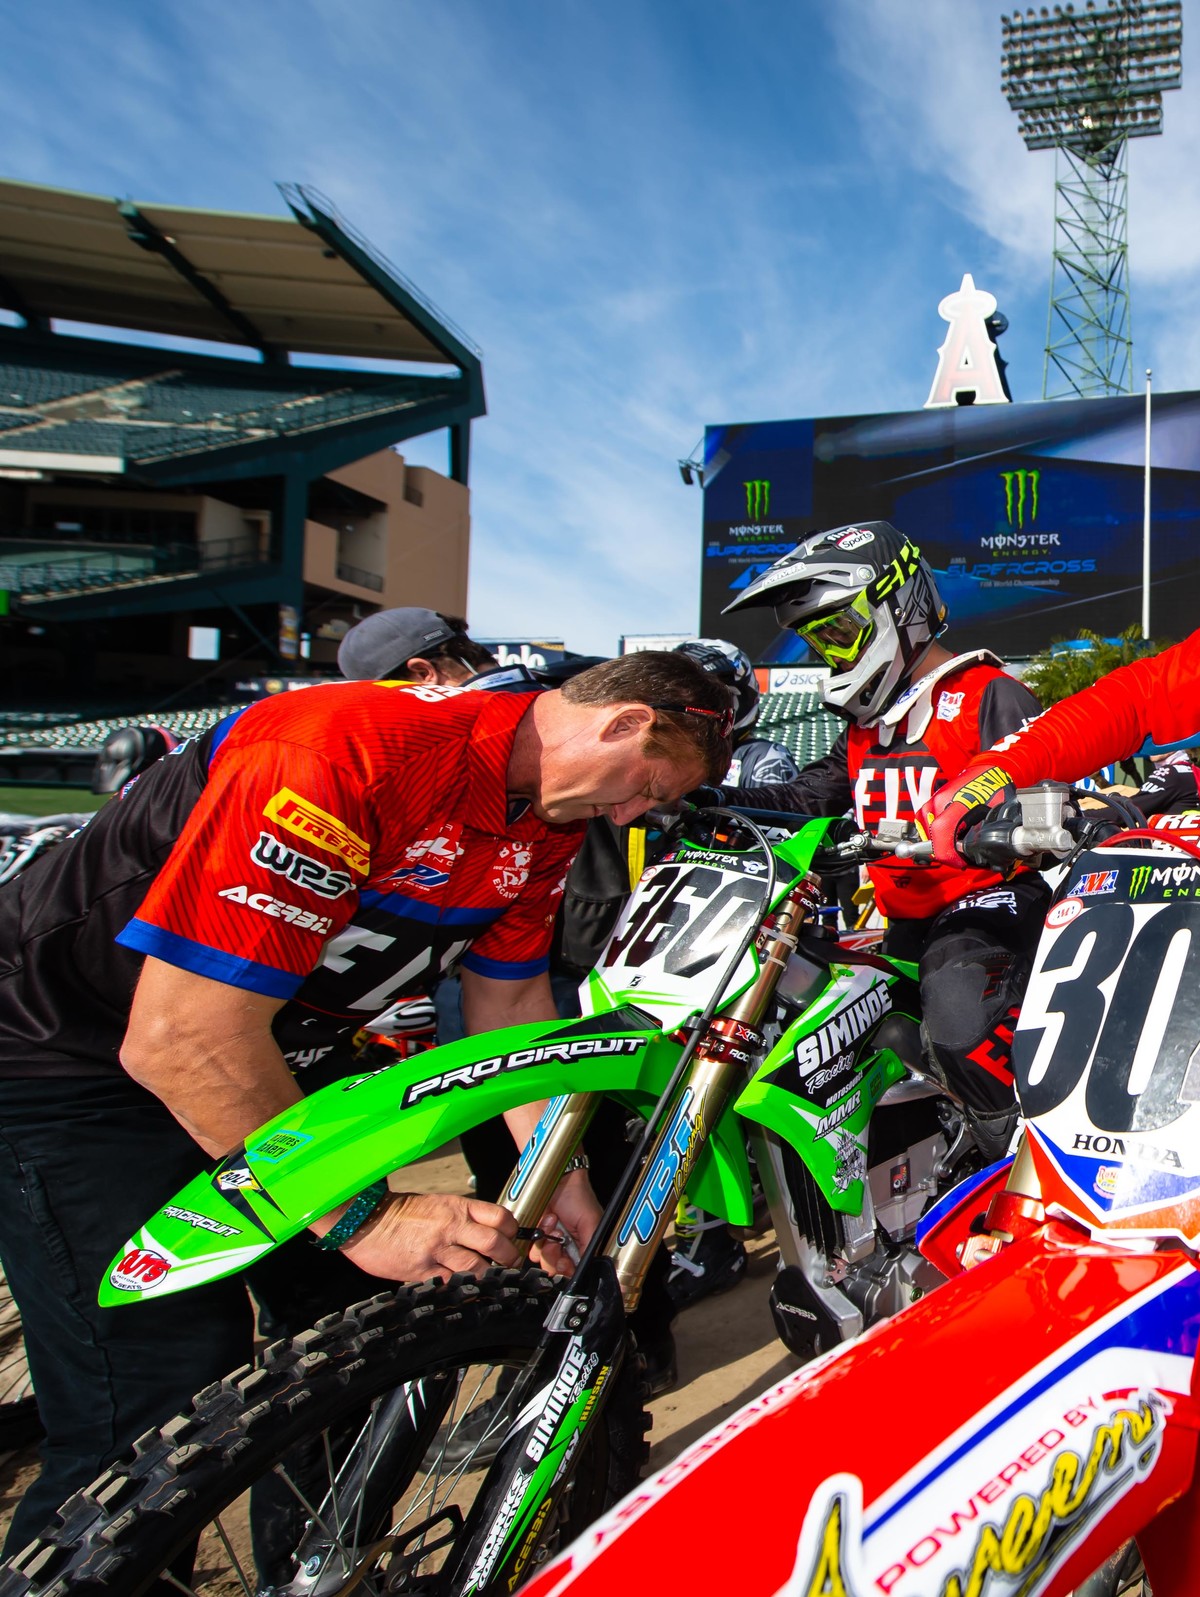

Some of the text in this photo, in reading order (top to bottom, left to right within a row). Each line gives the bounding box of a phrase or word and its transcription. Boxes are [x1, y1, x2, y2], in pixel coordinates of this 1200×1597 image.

[728, 524, 785, 538] MONSTER
[842, 532, 873, 549] Sports
[980, 532, 1061, 550] MONSTER
[946, 558, 1097, 579] SUPERCROSS
[790, 671, 823, 687] asics
[276, 798, 370, 868] PIRELLI
[252, 832, 355, 899] WPS
[684, 850, 739, 867] MONSTER
[1067, 869, 1119, 898] AMA
[797, 982, 893, 1078] SIMINOE
[408, 1057, 502, 1103] PRO
[507, 1037, 646, 1069] CIRCUIT
[805, 1051, 854, 1095] Racing
[816, 1089, 862, 1136] MMR
[221, 1171, 252, 1185] BOLT
[177, 1209, 242, 1237] CIRCUIT
[569, 1351, 600, 1404] Racing
[579, 1364, 609, 1422] HINSON
[525, 1343, 587, 1463] SIMINOE
[872, 1395, 1099, 1597] POWERED BY
[460, 1468, 526, 1597] WORKS
[508, 1496, 553, 1593] ACERBIS
